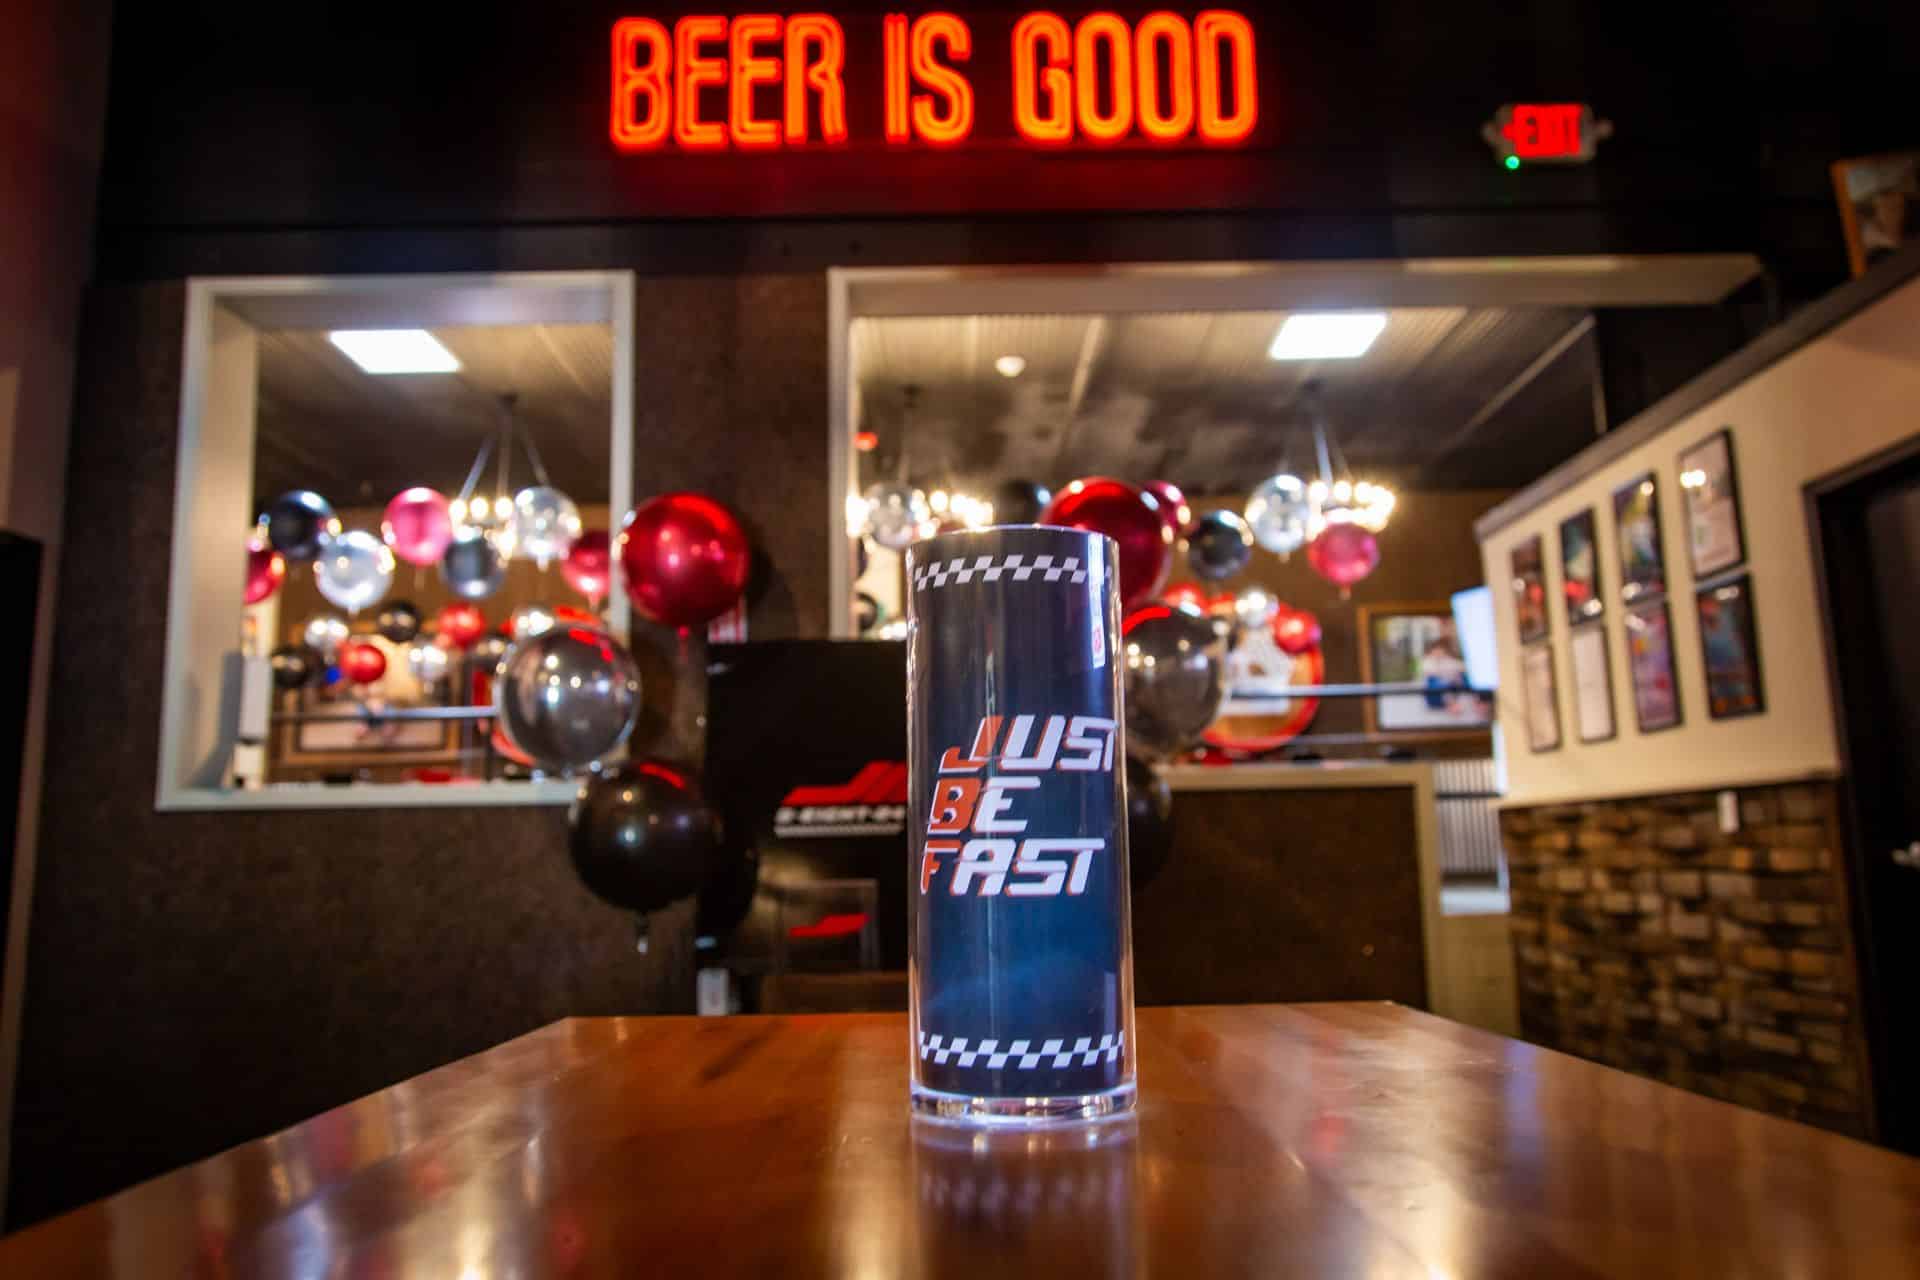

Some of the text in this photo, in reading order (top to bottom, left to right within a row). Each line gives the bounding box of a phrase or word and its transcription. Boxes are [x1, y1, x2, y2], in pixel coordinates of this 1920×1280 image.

[610, 10, 1259, 147] BEER IS GOOD
[1512, 103, 1582, 158] EXIT
[927, 776, 1041, 835] BE
[920, 837, 1106, 896] FAST
